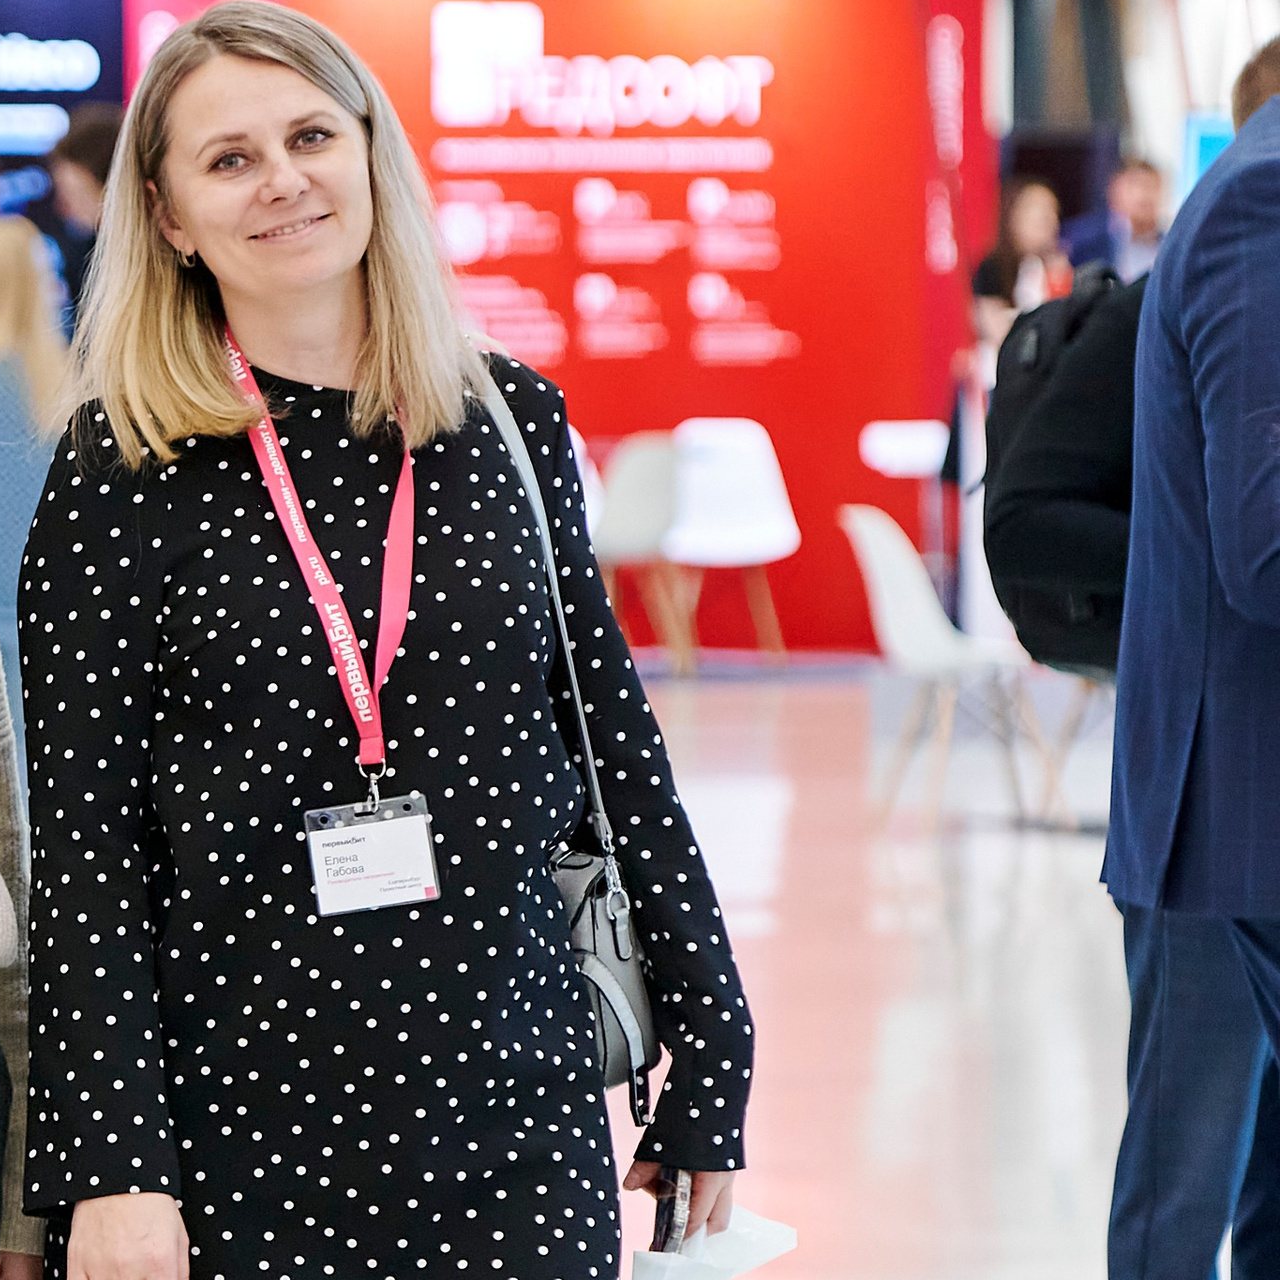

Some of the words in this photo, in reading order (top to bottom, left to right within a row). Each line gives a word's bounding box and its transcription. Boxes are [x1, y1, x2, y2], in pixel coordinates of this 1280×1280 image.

[281, 486, 308, 543] первыми
[324, 853, 359, 866] Елена
[326, 865, 365, 878] Габова
